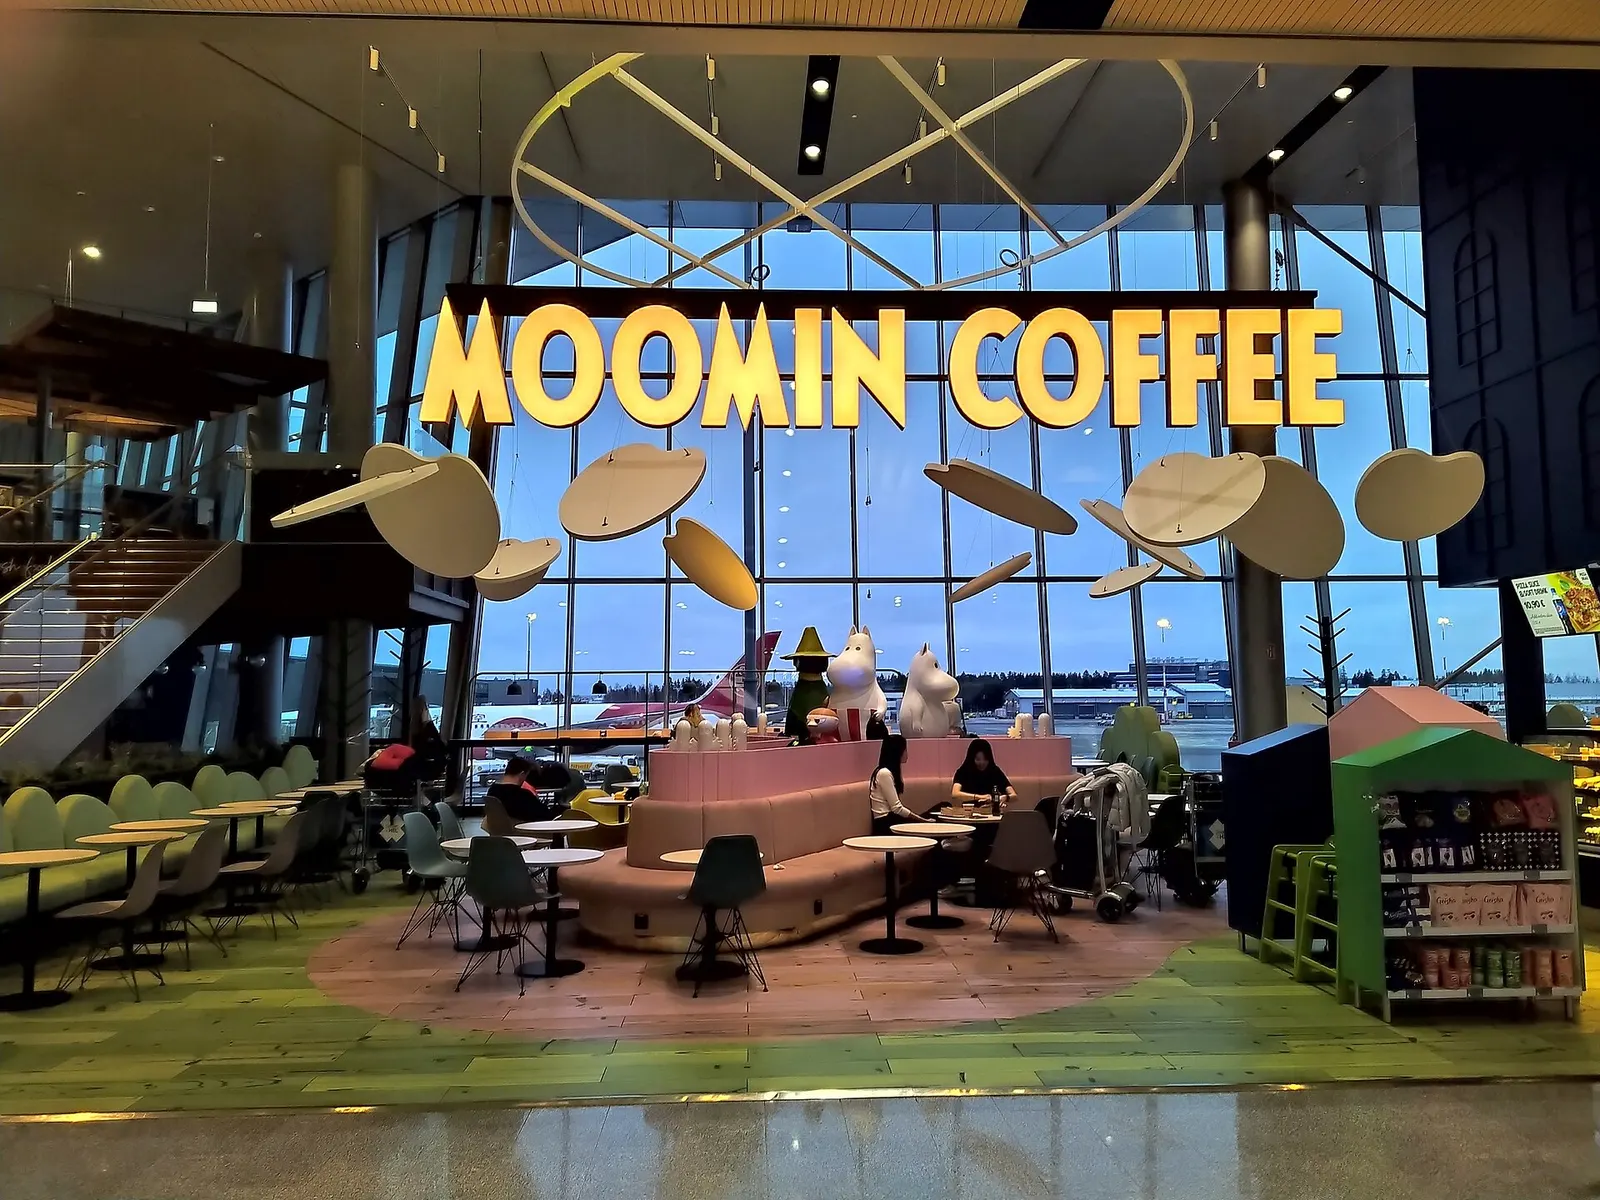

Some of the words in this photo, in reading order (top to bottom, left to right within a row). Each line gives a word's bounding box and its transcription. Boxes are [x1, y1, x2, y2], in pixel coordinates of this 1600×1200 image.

[419, 296, 907, 431] MOOMIN
[948, 307, 1345, 429] COFFEE
[1515, 582, 1528, 590] PIZZA
[1528, 580, 1540, 588] SLICE
[1523, 600, 1540, 610] 10,90
[1436, 896, 1456, 905] Geisha
[1484, 895, 1504, 904] Geisha
[1535, 895, 1555, 904] Geisha
